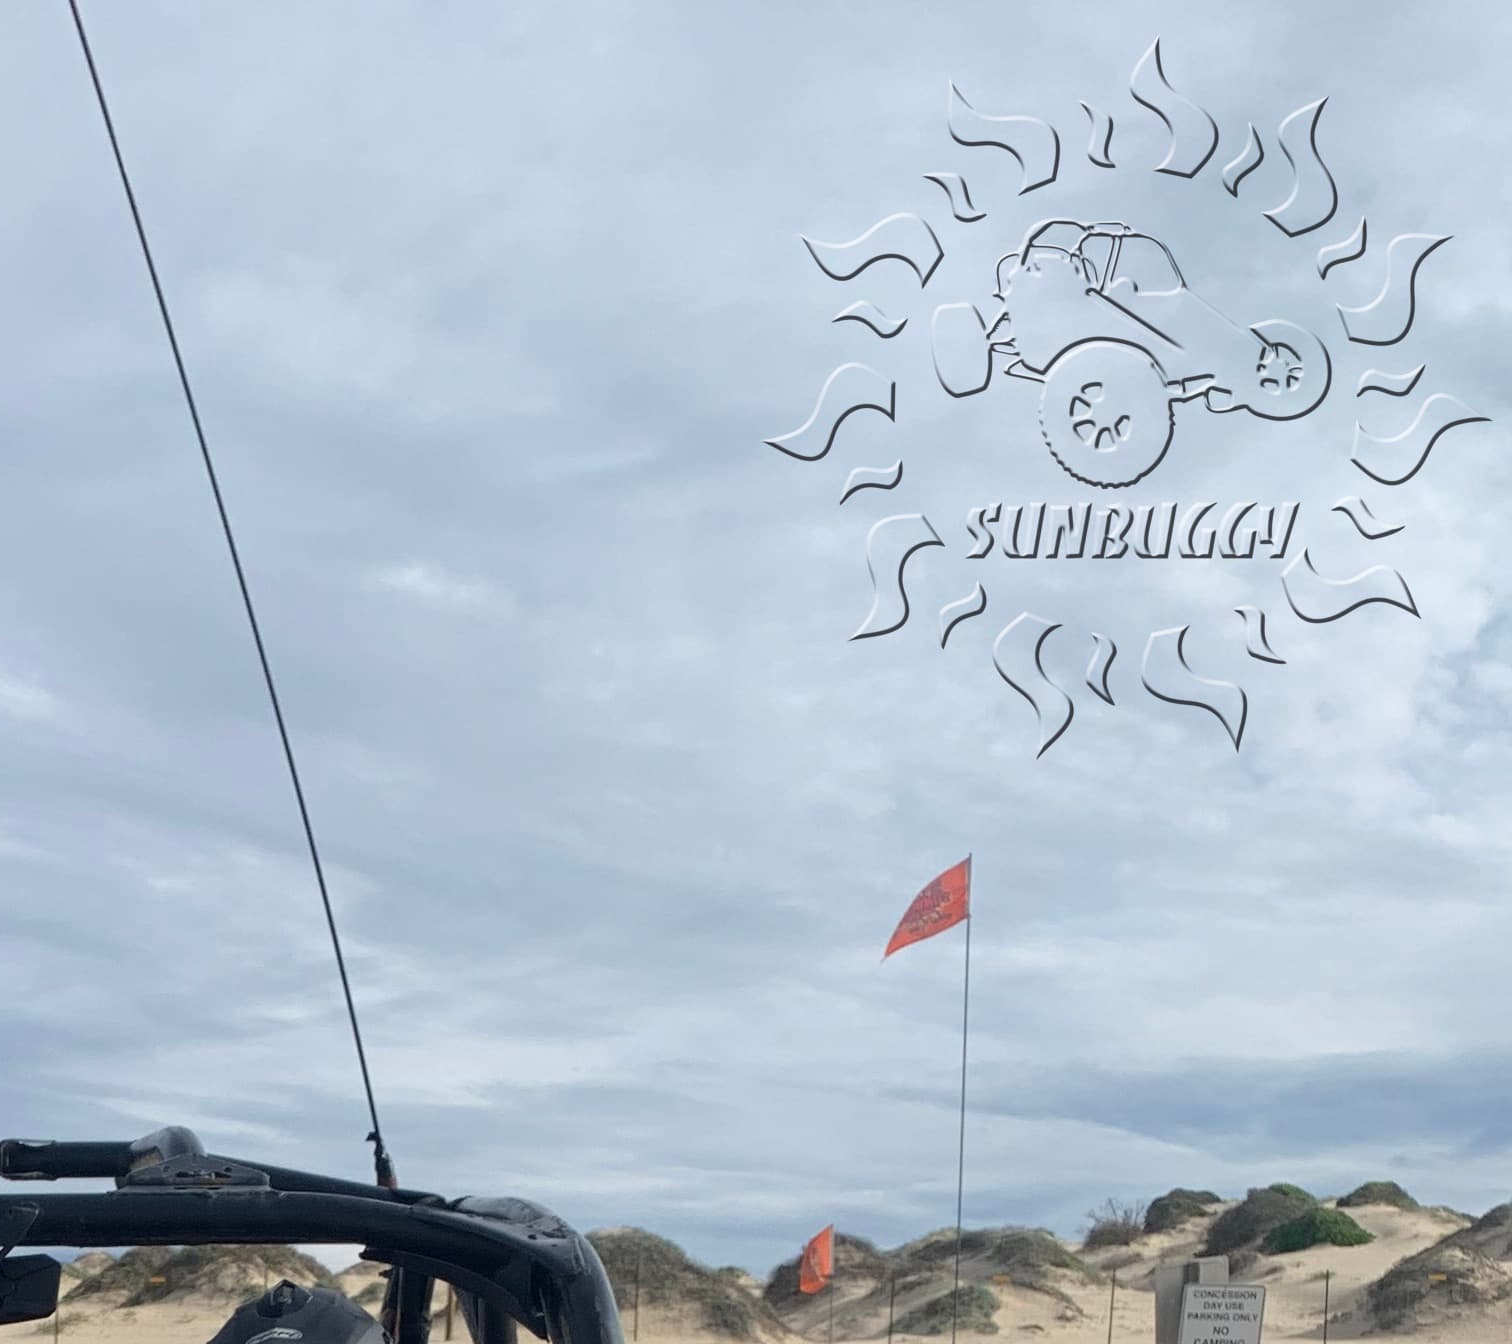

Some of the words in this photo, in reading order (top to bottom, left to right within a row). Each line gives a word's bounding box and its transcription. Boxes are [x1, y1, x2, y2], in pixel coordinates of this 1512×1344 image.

[1193, 1290, 1257, 1300] CONCESSION
[1203, 1301, 1222, 1310] DAY
[1225, 1302, 1244, 1310] USE
[1188, 1313, 1229, 1321] PARKING
[1233, 1313, 1258, 1322] ONLY
[1213, 1326, 1229, 1335] NO
